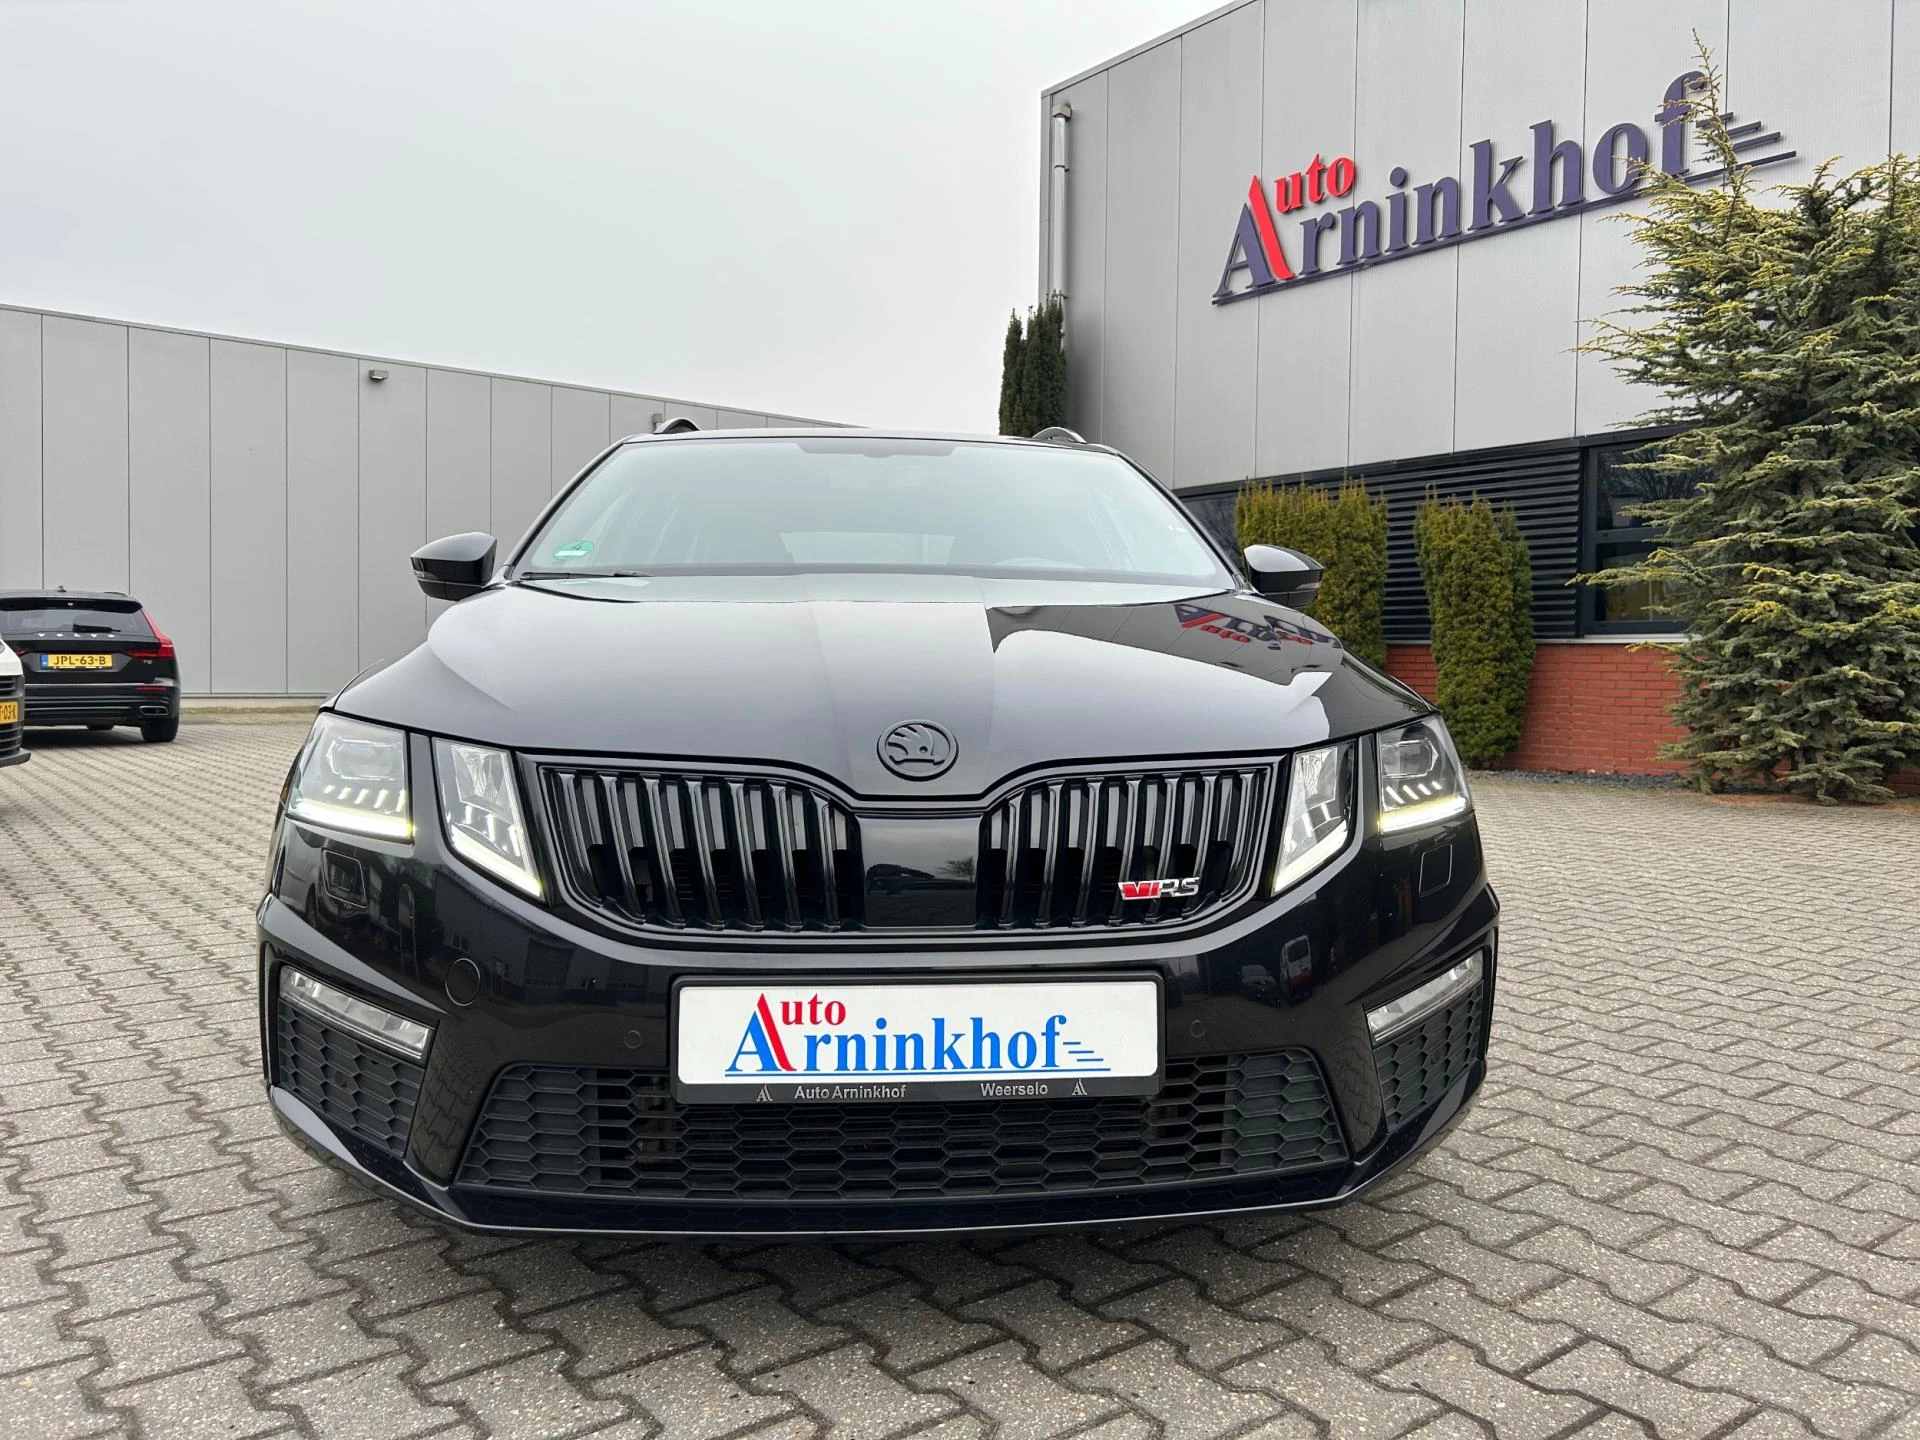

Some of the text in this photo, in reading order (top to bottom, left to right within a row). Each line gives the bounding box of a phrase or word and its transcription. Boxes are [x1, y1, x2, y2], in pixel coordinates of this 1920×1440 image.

[1212, 70, 1707, 299] Arninkhof
[53, 655, 106, 666] JPL-63-B
[726, 1010, 1066, 1072] Arninkhof
[794, 1086, 830, 1099] Auto
[832, 1084, 907, 1099] Arninkhof
[980, 1082, 1049, 1097] Weerselo
